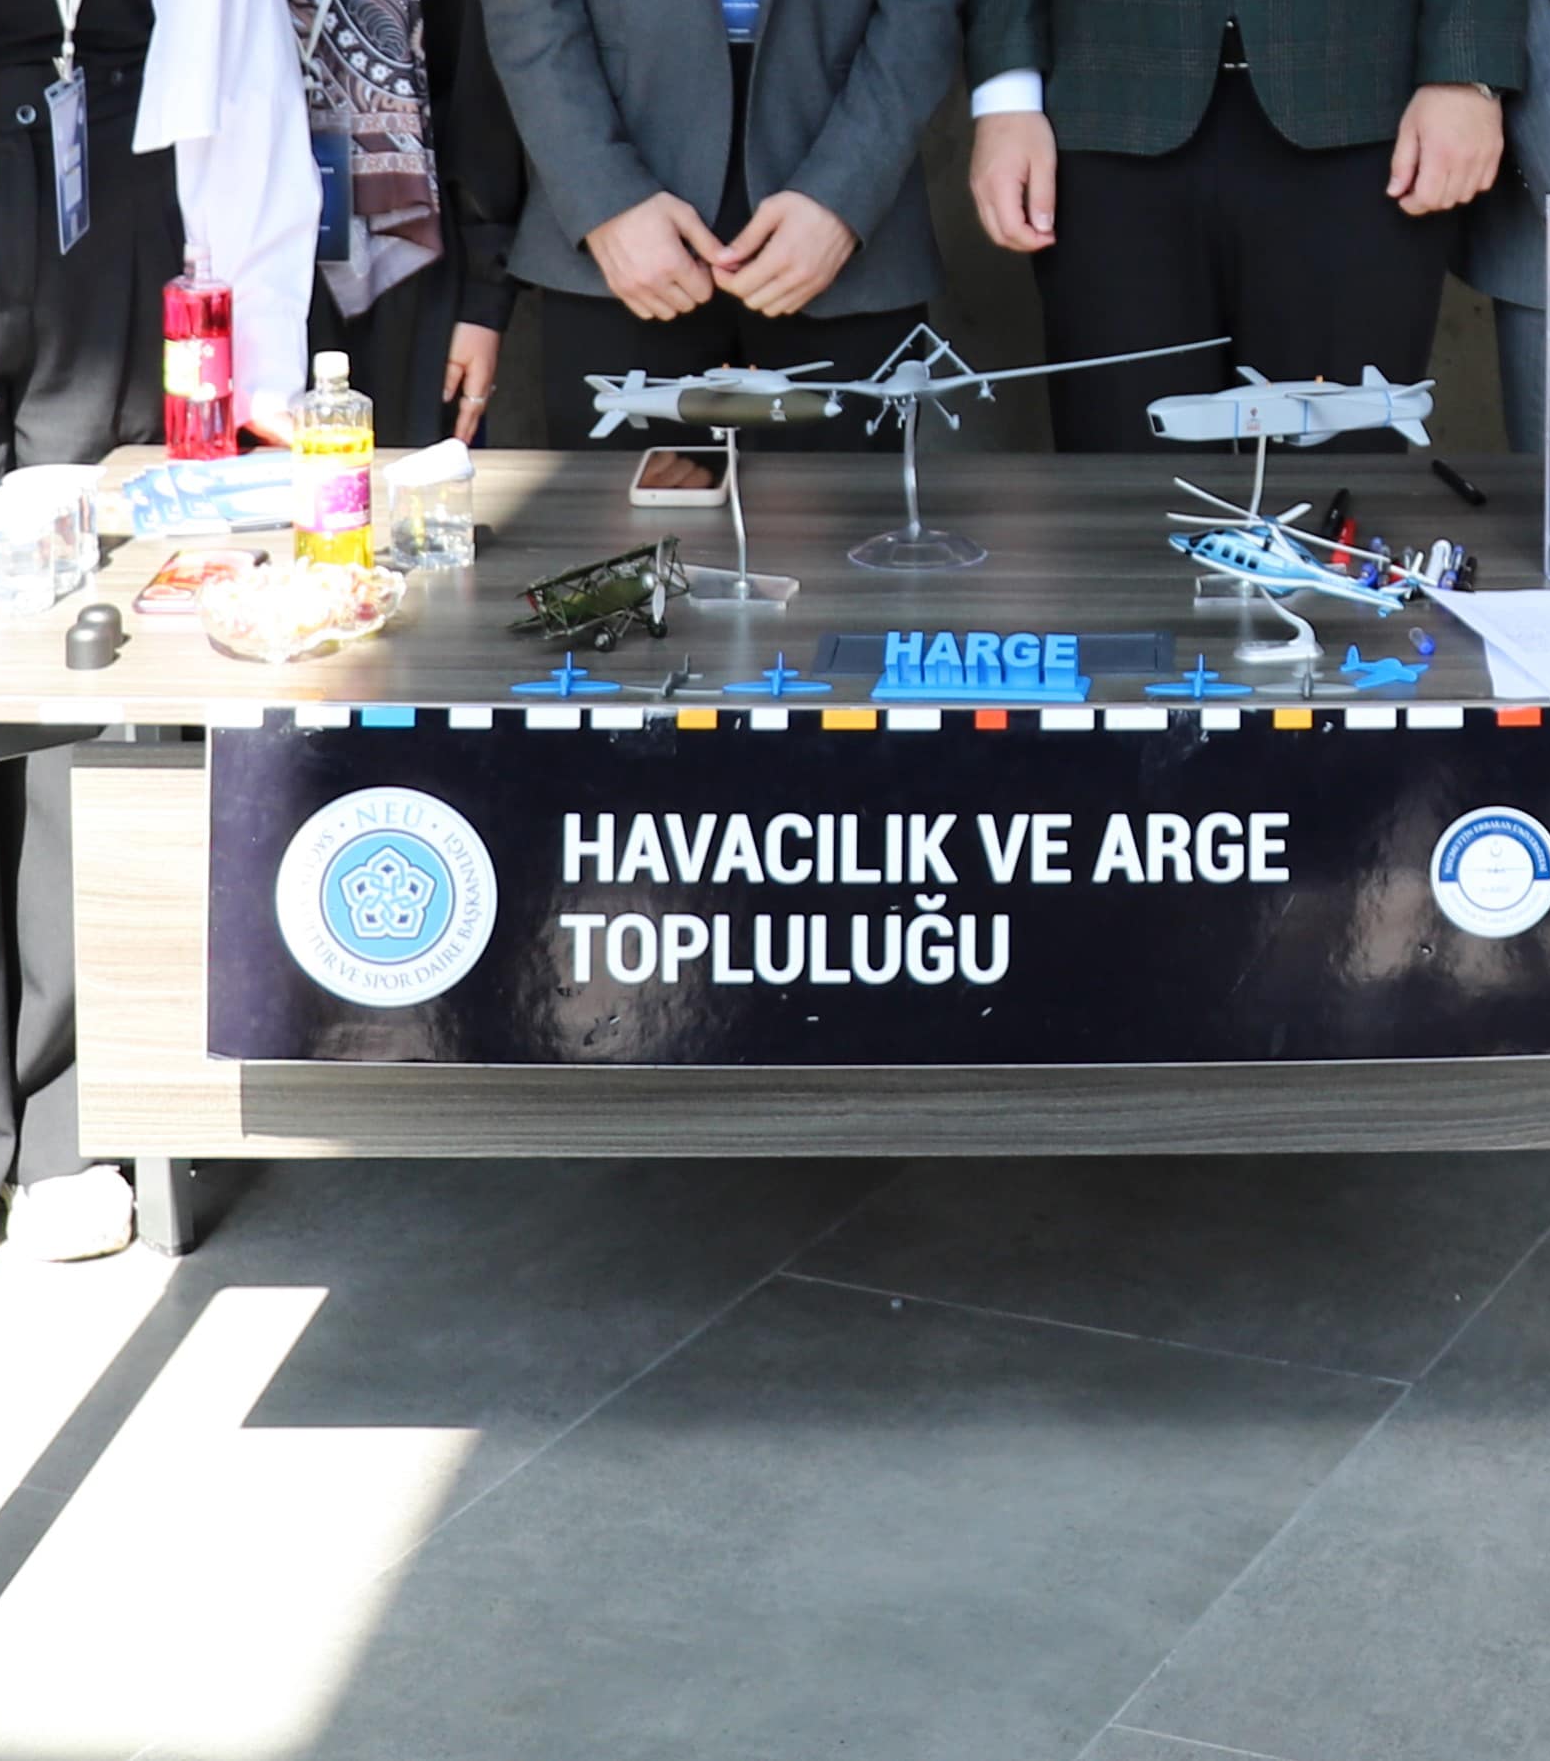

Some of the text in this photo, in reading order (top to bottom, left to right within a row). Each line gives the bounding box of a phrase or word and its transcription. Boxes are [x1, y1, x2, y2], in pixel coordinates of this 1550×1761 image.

[885, 631, 1078, 668] HARGE
[561, 812, 1290, 884] HAVACILIK VE ARGE
[559, 893, 1010, 985] TOPLULUĞU
[363, 970, 414, 990] SPOR
